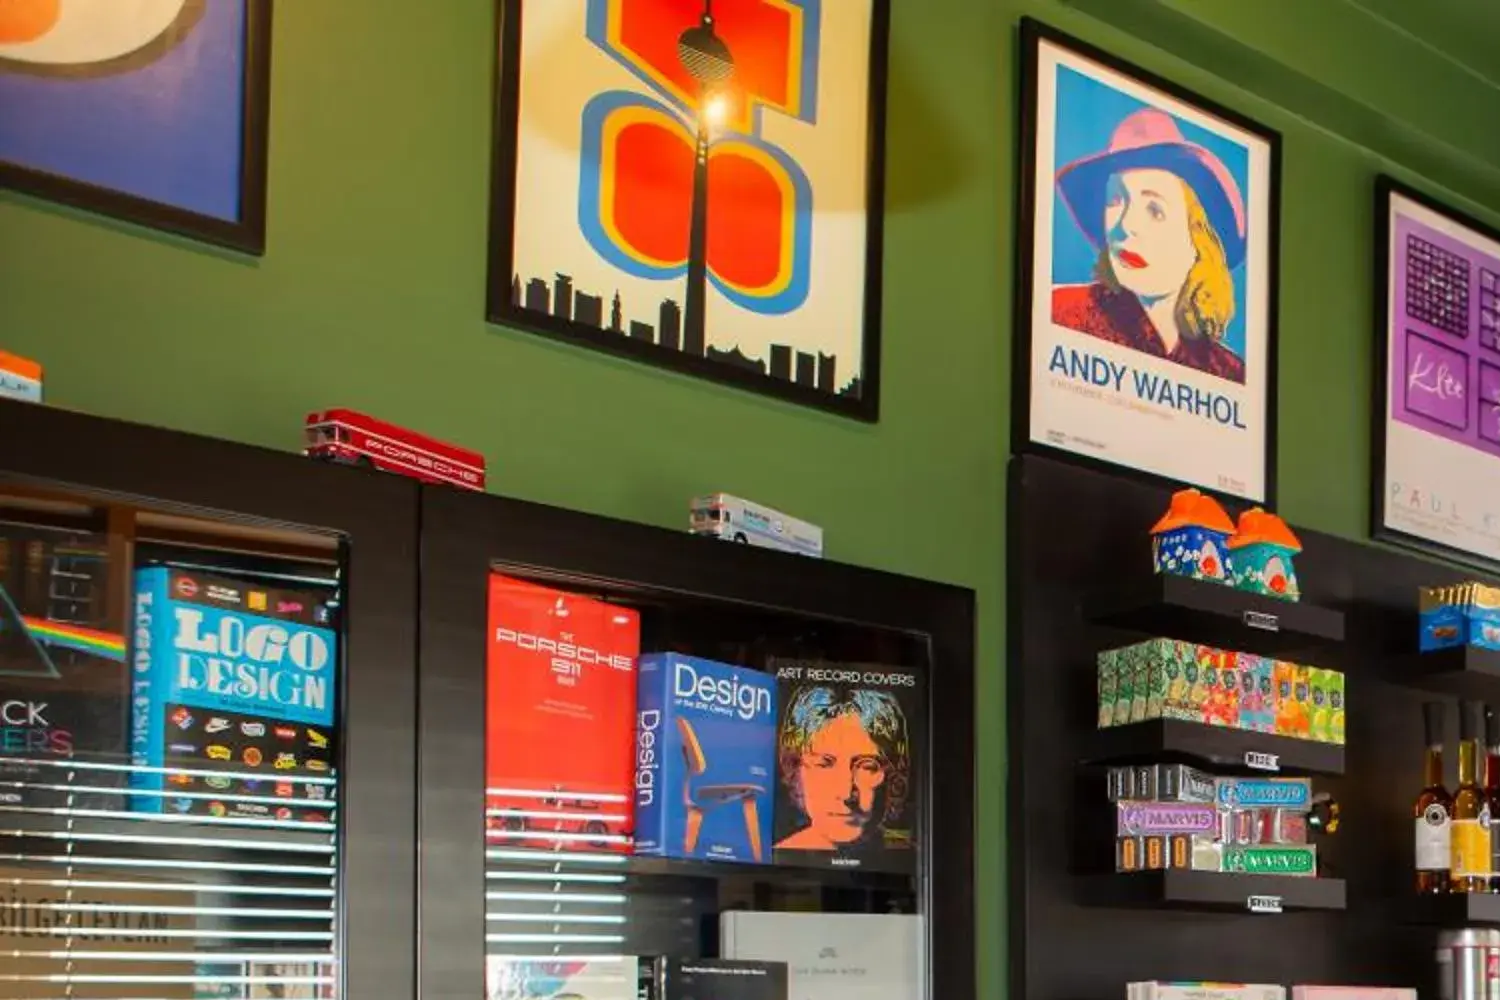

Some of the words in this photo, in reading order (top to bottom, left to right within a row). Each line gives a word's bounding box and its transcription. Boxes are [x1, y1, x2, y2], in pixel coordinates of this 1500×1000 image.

[1050, 346, 1126, 391] ANDY
[1133, 370, 1246, 428] WARHOL
[1410, 353, 1463, 399] Klee
[1392, 482, 1461, 519] PAUL
[174, 607, 328, 671] LOGO
[496, 627, 632, 671] PORSCHE
[177, 653, 325, 709] DESIGN
[551, 657, 581, 677] 911
[776, 667, 803, 680] ART
[807, 668, 860, 683] RECORD
[863, 672, 915, 686] COVERS
[0, 700, 48, 726] CK
[674, 663, 771, 720] Design
[0, 729, 73, 754] ERS
[635, 709, 660, 806] Design
[1148, 812, 1210, 826] MARVIS
